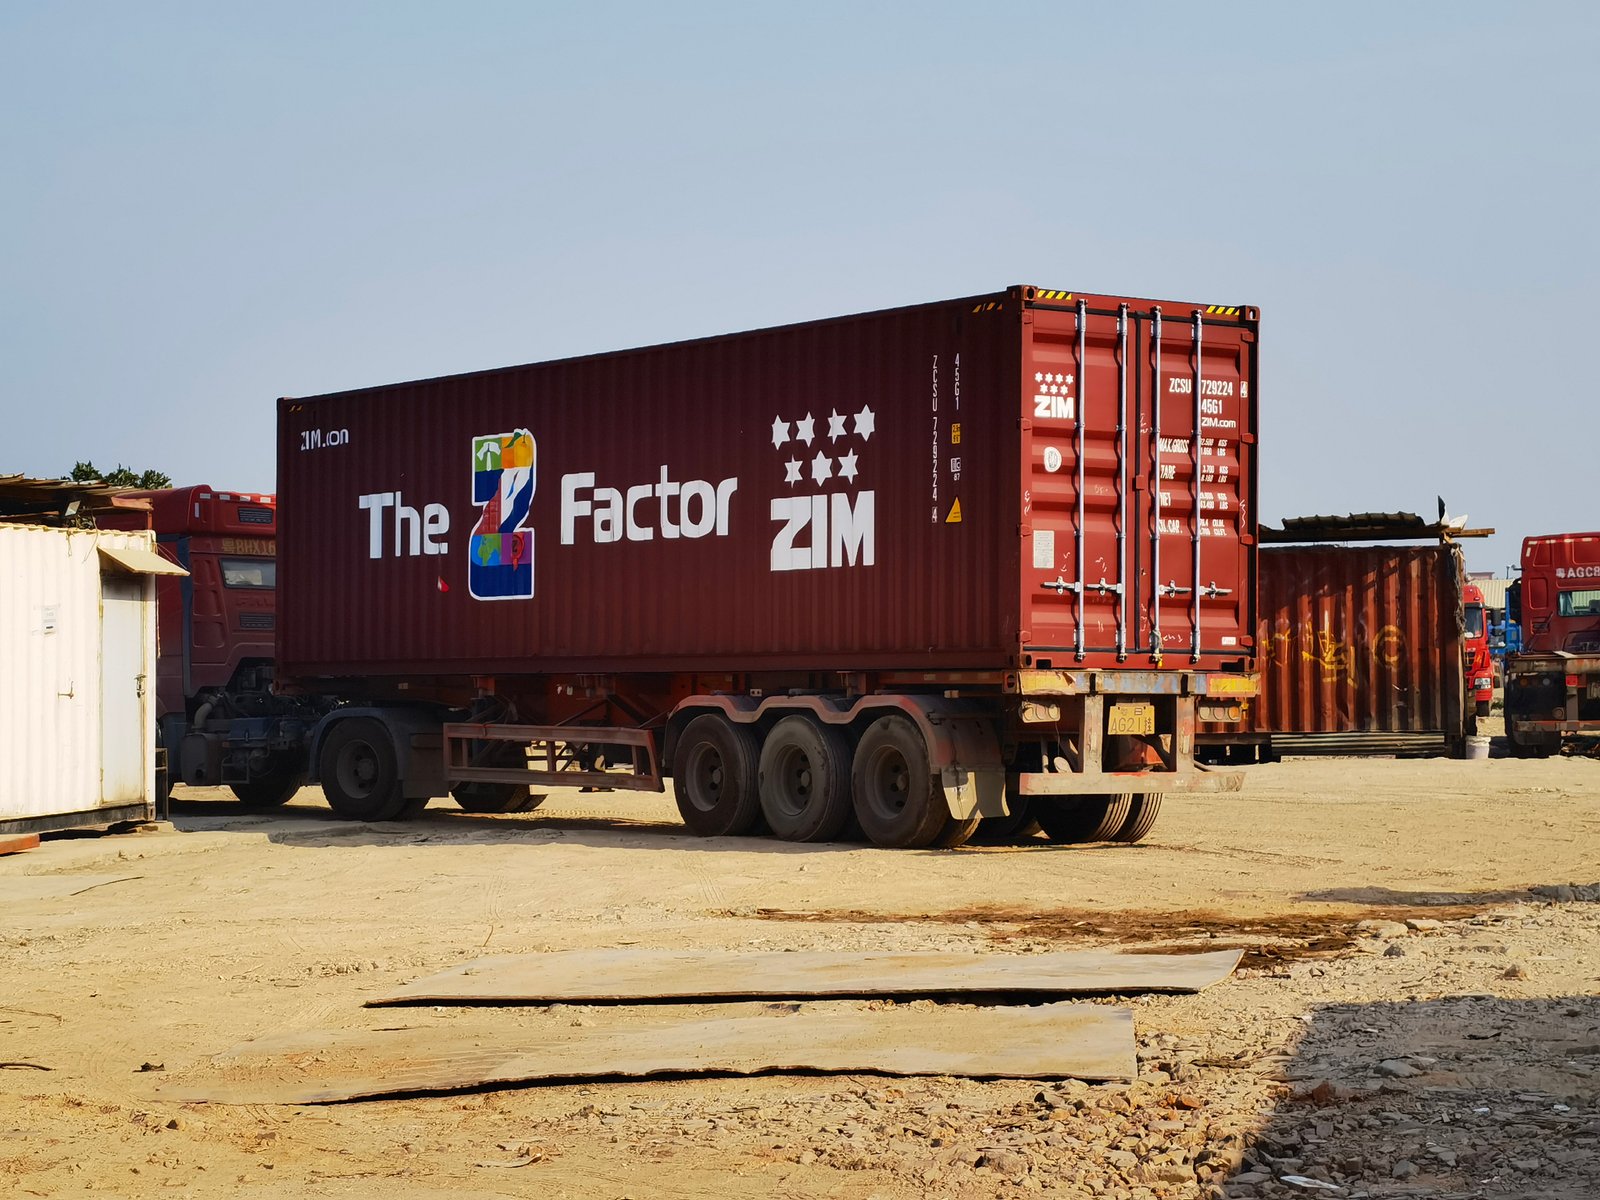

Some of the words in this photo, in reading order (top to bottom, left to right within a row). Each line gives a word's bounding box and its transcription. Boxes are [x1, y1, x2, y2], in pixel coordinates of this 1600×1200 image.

[1169, 377, 1192, 395] ZCSU
[1201, 379, 1233, 397] 729224
[1034, 395, 1074, 419] ZIM
[1201, 399, 1223, 416] 45G1
[1201, 416, 1236, 428] ZIM.com
[359, 491, 449, 559] The
[560, 465, 738, 545] Factor
[770, 490, 875, 572] ZIM
